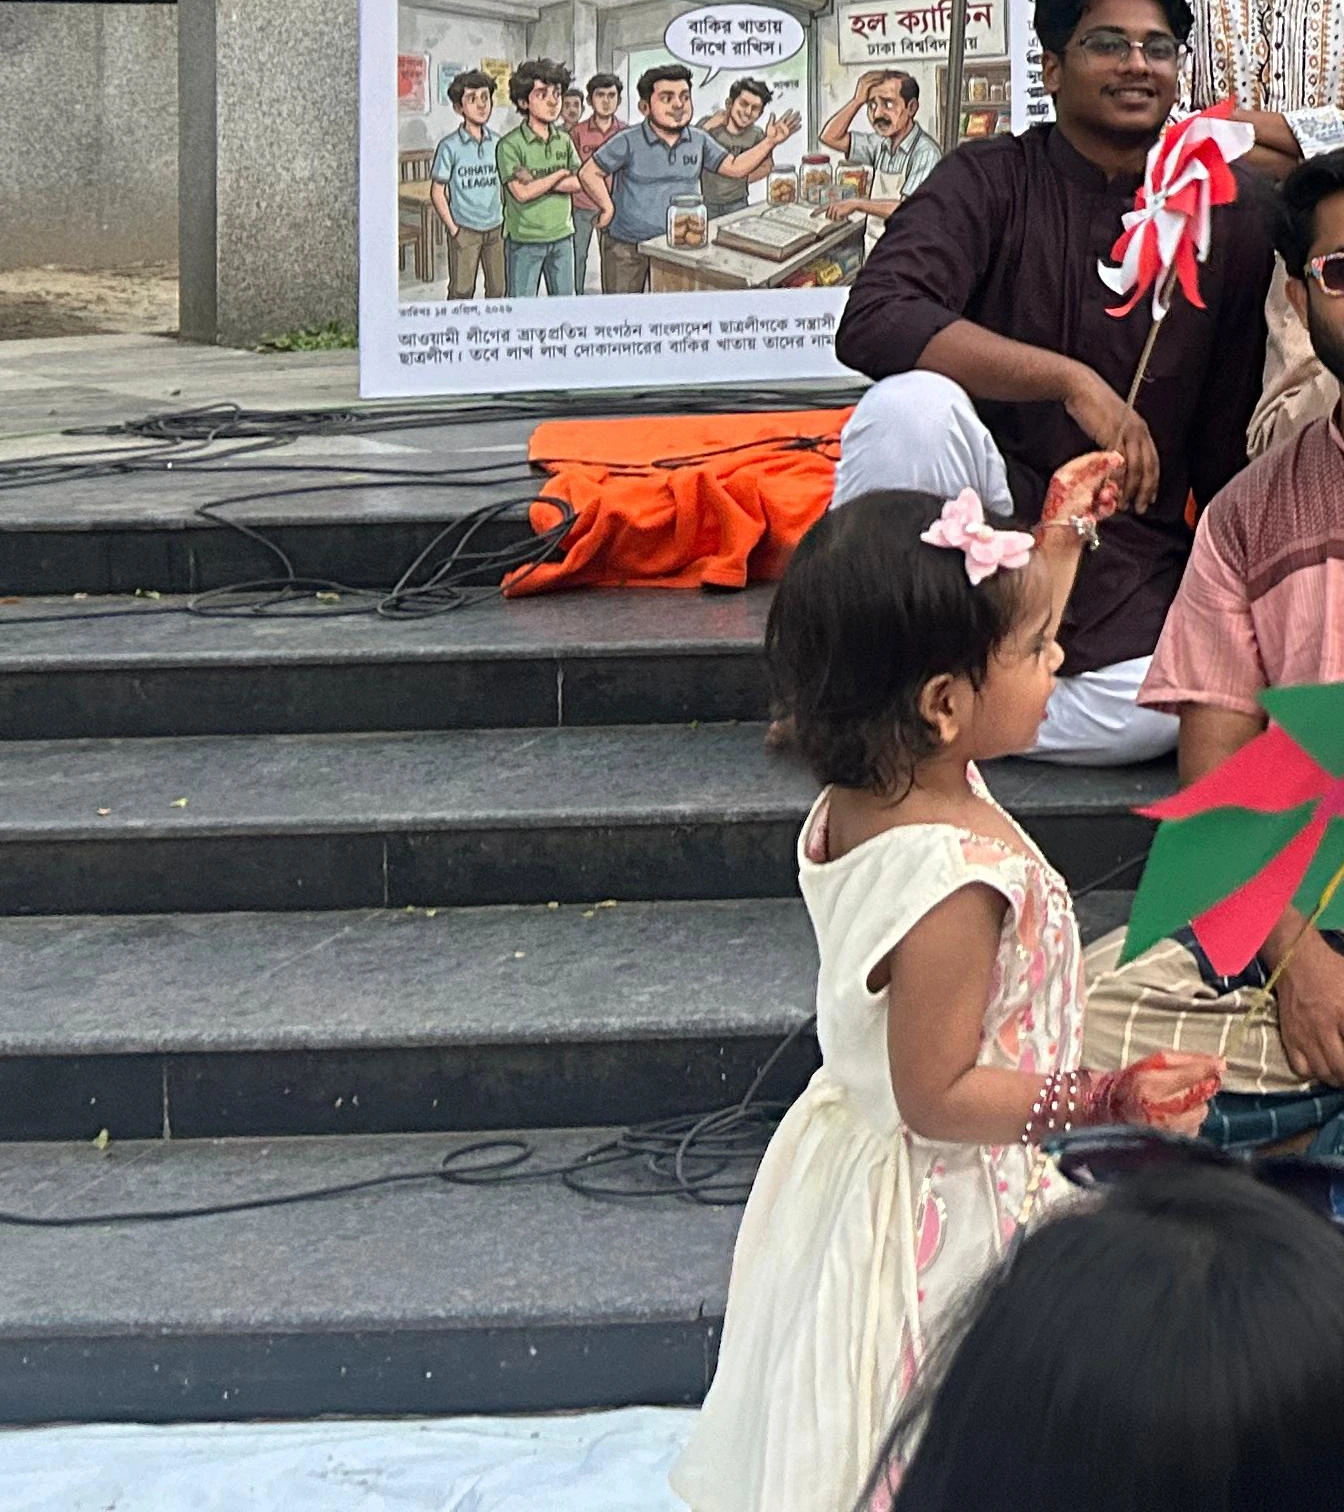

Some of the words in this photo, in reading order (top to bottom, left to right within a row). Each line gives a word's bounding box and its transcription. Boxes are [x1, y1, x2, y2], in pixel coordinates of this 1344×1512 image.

[687, 14, 733, 35] বাকির
[738, 19, 784, 35] খাতায়
[848, 12, 888, 40] হল
[690, 36, 727, 56] লিখে
[867, 41, 896, 56] ঢাকা
[682, 154, 698, 166] DU
[461, 178, 497, 190] LEAGUE
[398, 326, 459, 348] আওয়ামী
[466, 326, 510, 345] লীগের
[594, 319, 642, 338] সংগঠন
[649, 319, 713, 337] বাংলাদেশ
[719, 314, 788, 335] ছাত্রলীগকে
[469, 347, 500, 362] তবে
[506, 345, 533, 361] লাখ
[540, 344, 567, 360] লাখ
[573, 340, 662, 358] দোকানদারের
[669, 335, 709, 354] বাকির
[716, 335, 756, 352] খাতায়
[762, 335, 804, 350] তাদের
